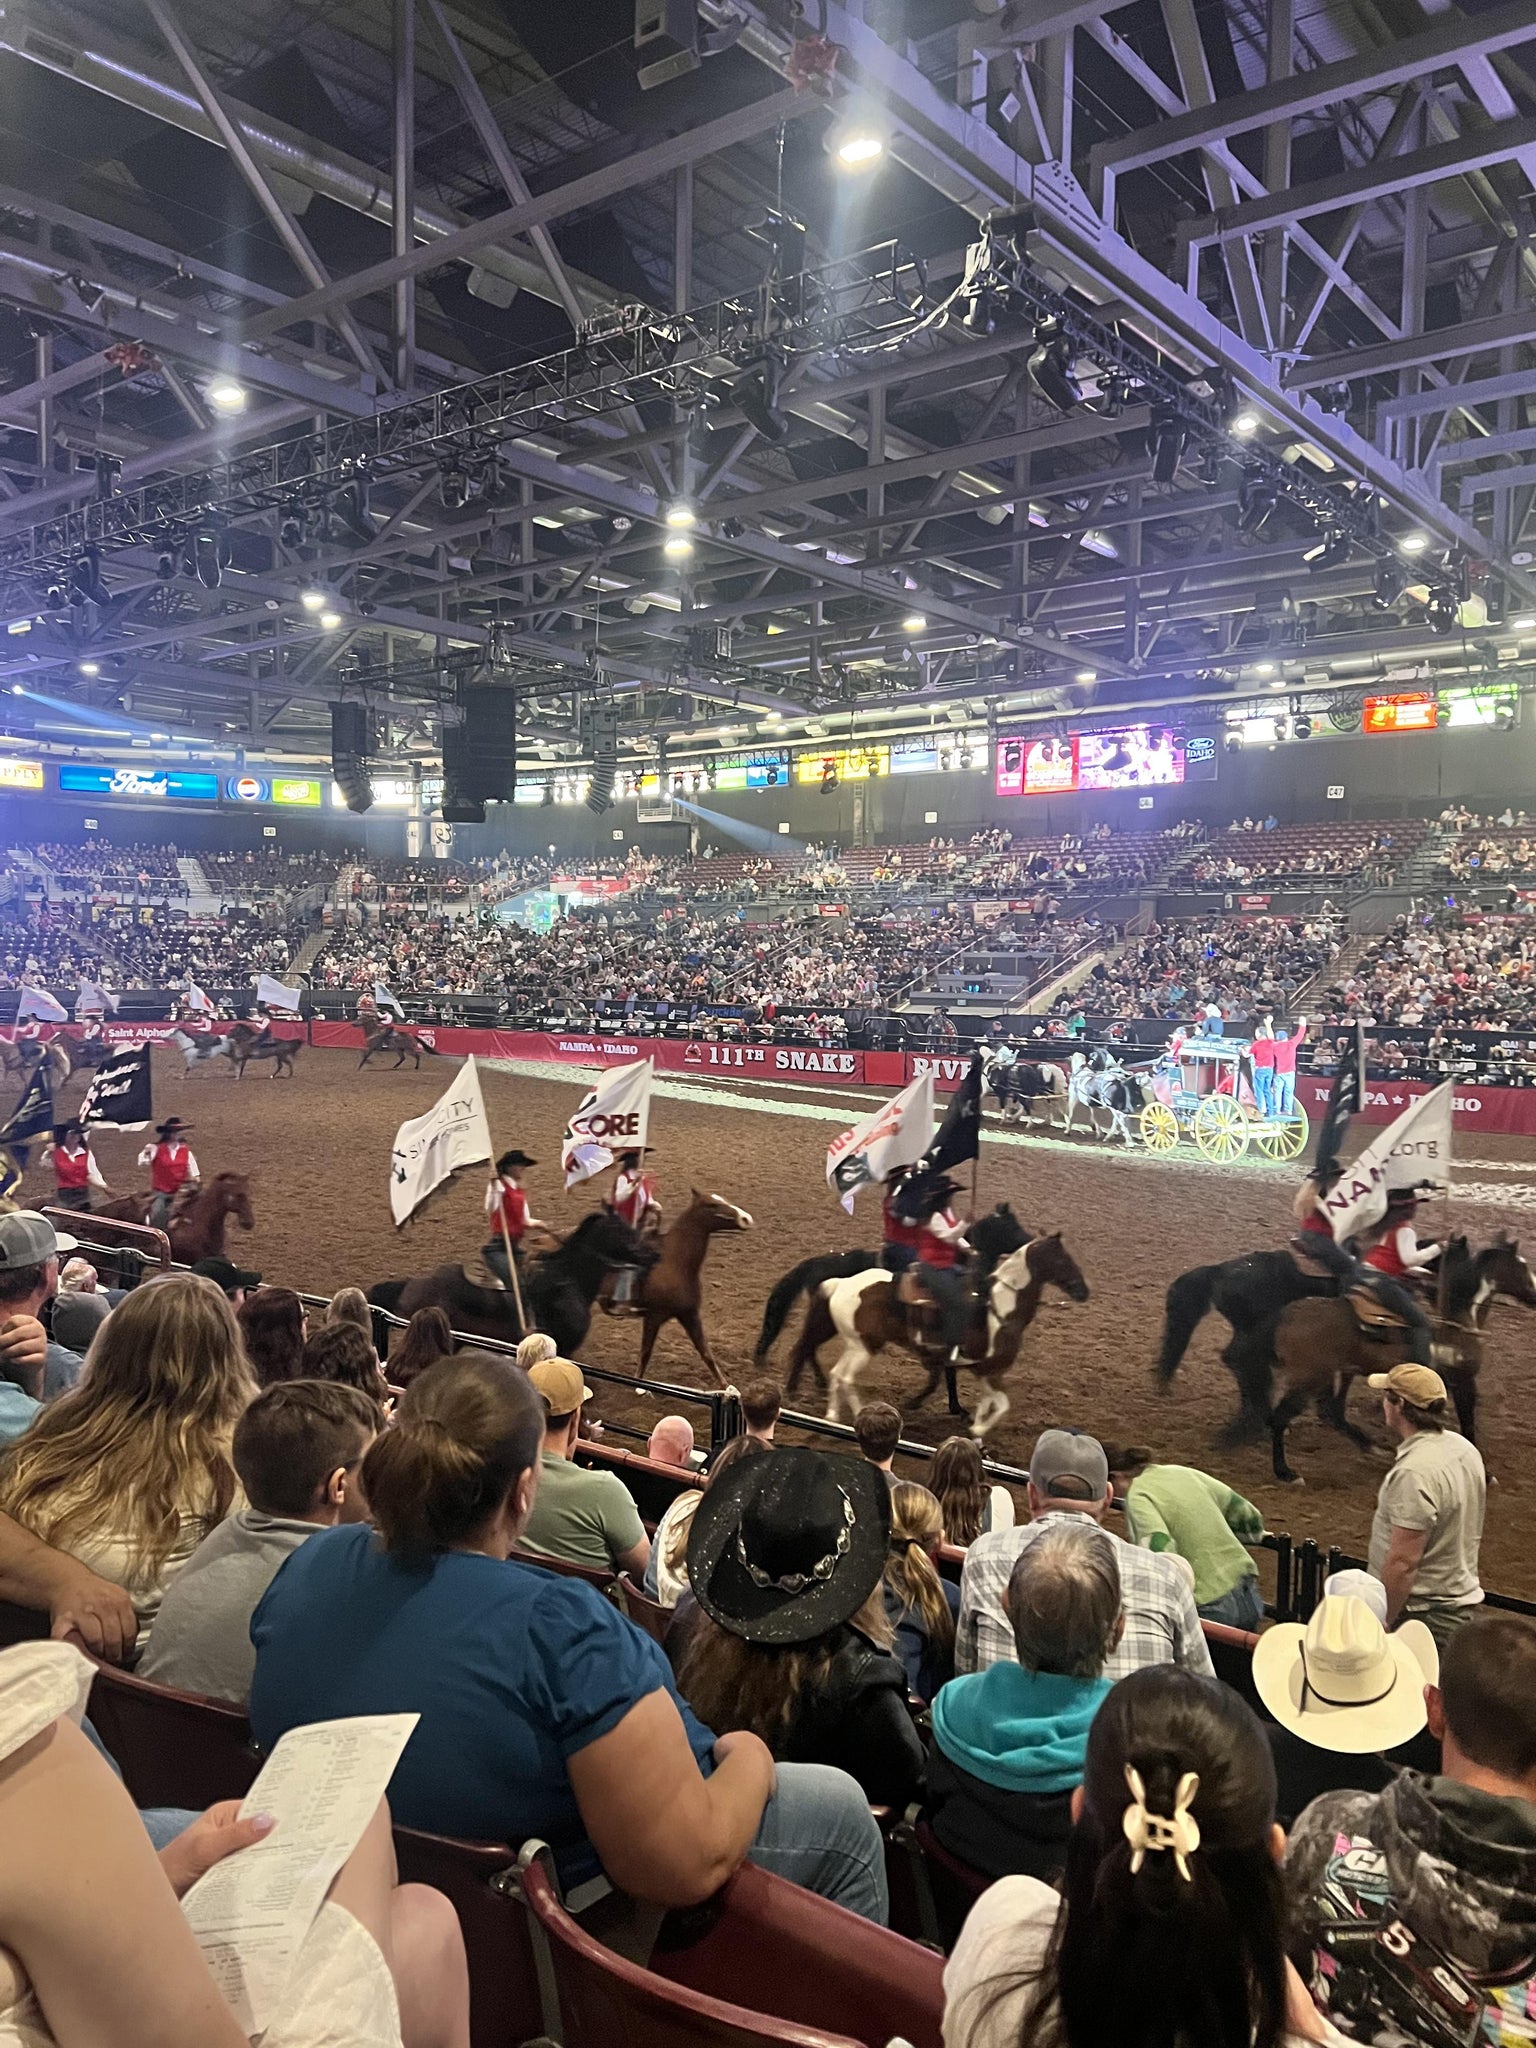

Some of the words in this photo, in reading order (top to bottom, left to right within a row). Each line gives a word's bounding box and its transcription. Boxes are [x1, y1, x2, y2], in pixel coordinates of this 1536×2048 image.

[1187, 749, 1215, 758] IDAHO
[110, 771, 167, 795] Ford
[108, 1028, 133, 1037] Saint
[560, 1042, 595, 1052] NAMPA
[603, 1044, 638, 1054] IDAHO
[776, 1050, 855, 1073] SNAKE
[1315, 1088, 1388, 1106] NPA
